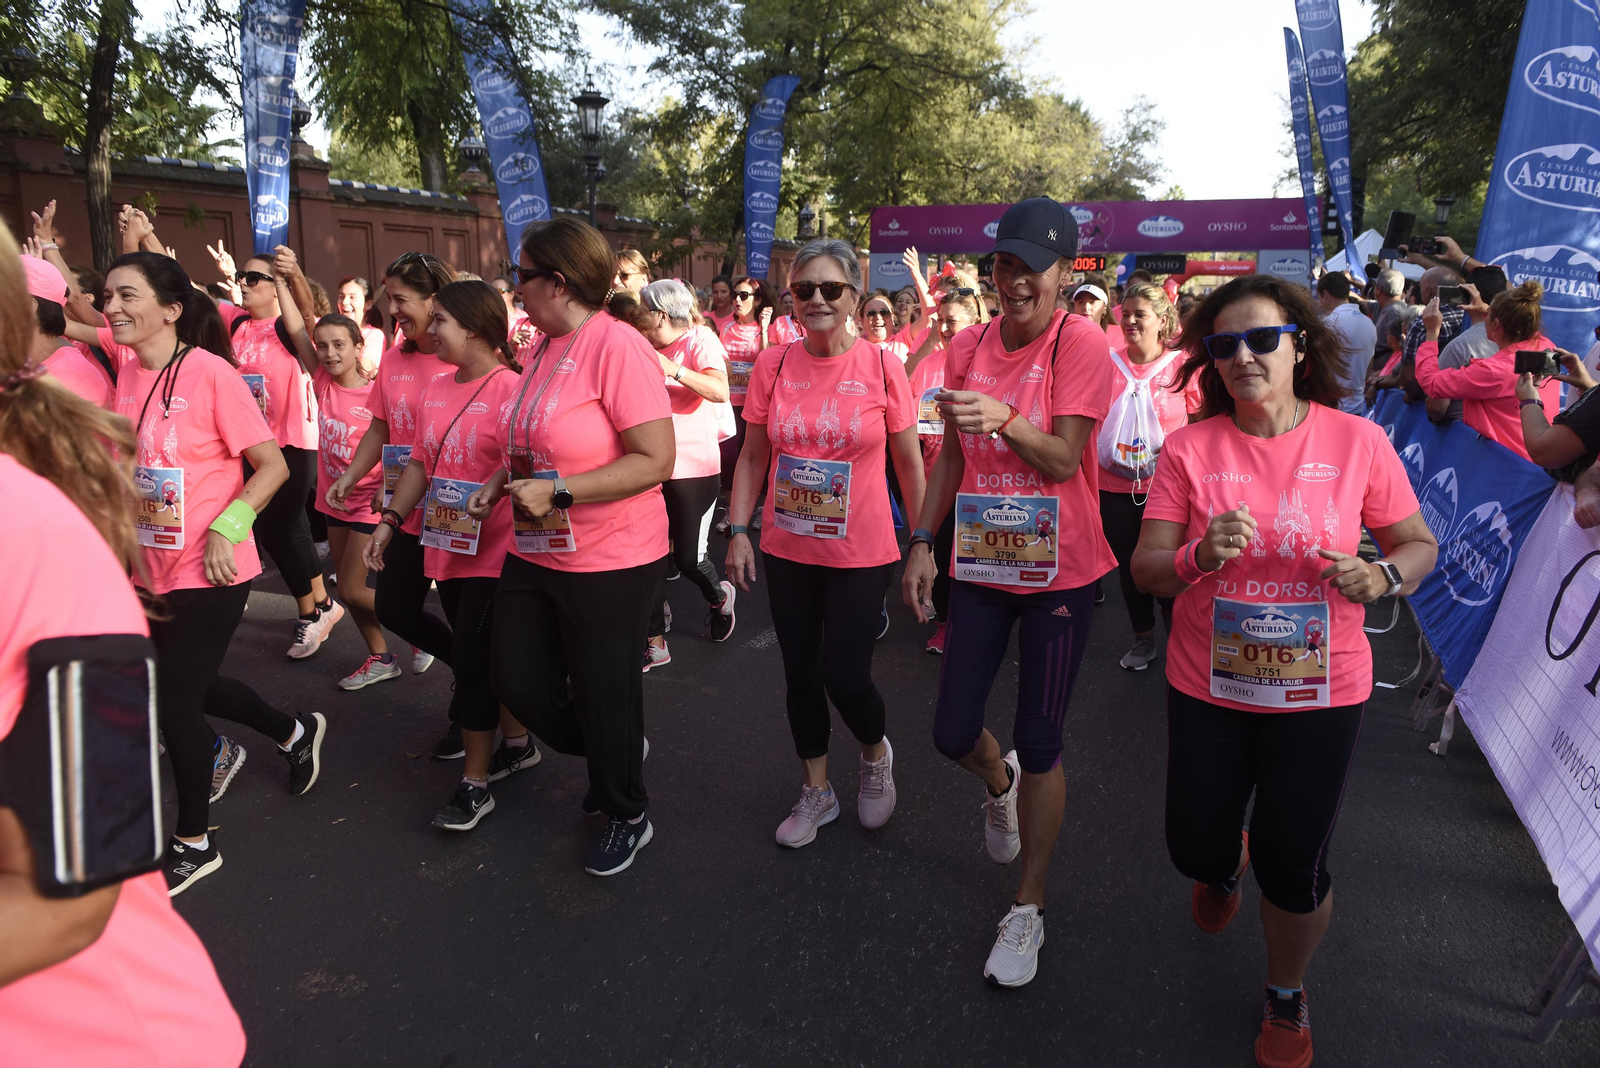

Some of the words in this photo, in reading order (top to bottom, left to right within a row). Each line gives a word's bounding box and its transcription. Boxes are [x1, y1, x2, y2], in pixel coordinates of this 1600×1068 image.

[928, 226, 963, 235] OYSHO
[1141, 222, 1181, 233] ASTURIANA
[1207, 221, 1247, 232] OYSHO
[1270, 223, 1309, 232] Santander
[878, 229, 909, 237] Santander
[880, 265, 908, 273] ASTURIANA
[1143, 260, 1180, 270] OYSHO
[1271, 262, 1308, 272] ASTURIANA
[791, 470, 824, 483] ASTURIANA
[1202, 471, 1252, 485] OYSHO
[1297, 469, 1337, 478] ASTURIANA
[790, 487, 822, 505] 016
[435, 505, 459, 521] 016
[783, 510, 800, 519] CARRERA
[796, 505, 813, 514] 4541
[985, 511, 1027, 522] ASTURIANA
[984, 530, 1026, 549] 016
[995, 551, 1017, 560] 3799
[975, 558, 1000, 566] CARRERA
[963, 568, 995, 578] OYSHO
[1215, 579, 1237, 595] TU
[1218, 614, 1236, 622] SUMA
[1244, 621, 1294, 634] ASTURIANA
[1243, 643, 1294, 665] 016
[1254, 666, 1281, 678] 3751
[1233, 673, 1260, 685] CARRERA
[1220, 683, 1254, 698] OYSHO
